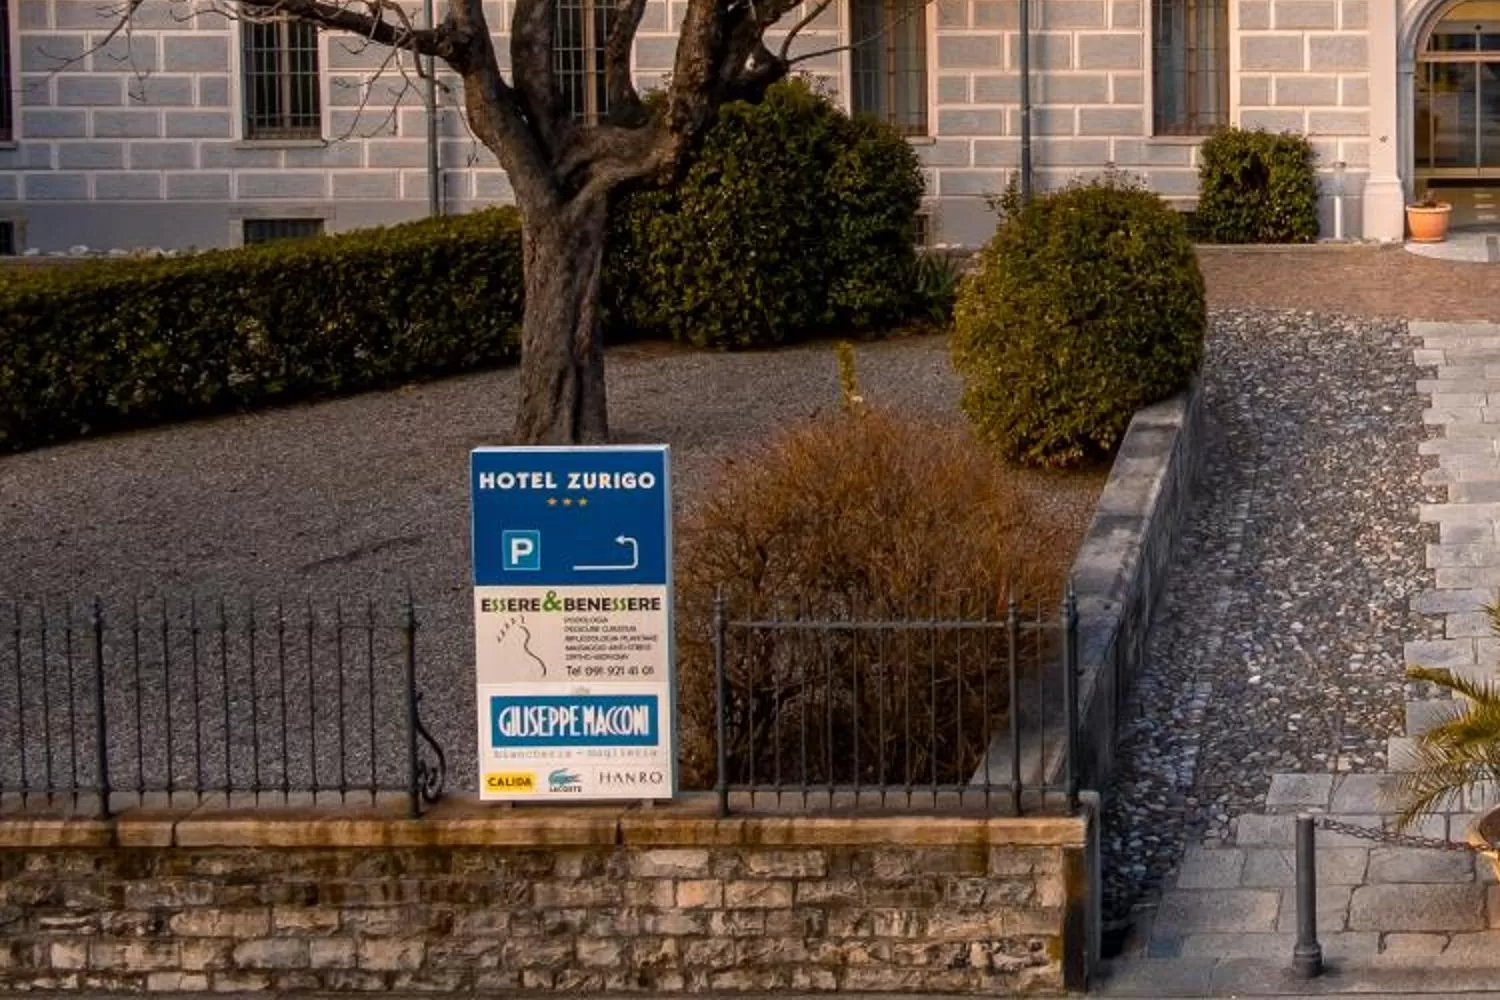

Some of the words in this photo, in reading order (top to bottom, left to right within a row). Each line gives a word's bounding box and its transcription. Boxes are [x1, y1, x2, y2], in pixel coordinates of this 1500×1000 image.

[479, 472, 557, 489] HOTEL
[567, 472, 656, 489] ZURIGO
[511, 537, 534, 565] P
[499, 705, 580, 737] GIUSEPPE
[584, 705, 649, 737] MACCONI
[487, 776, 532, 787] CALIDA
[600, 771, 663, 785] HANRO
